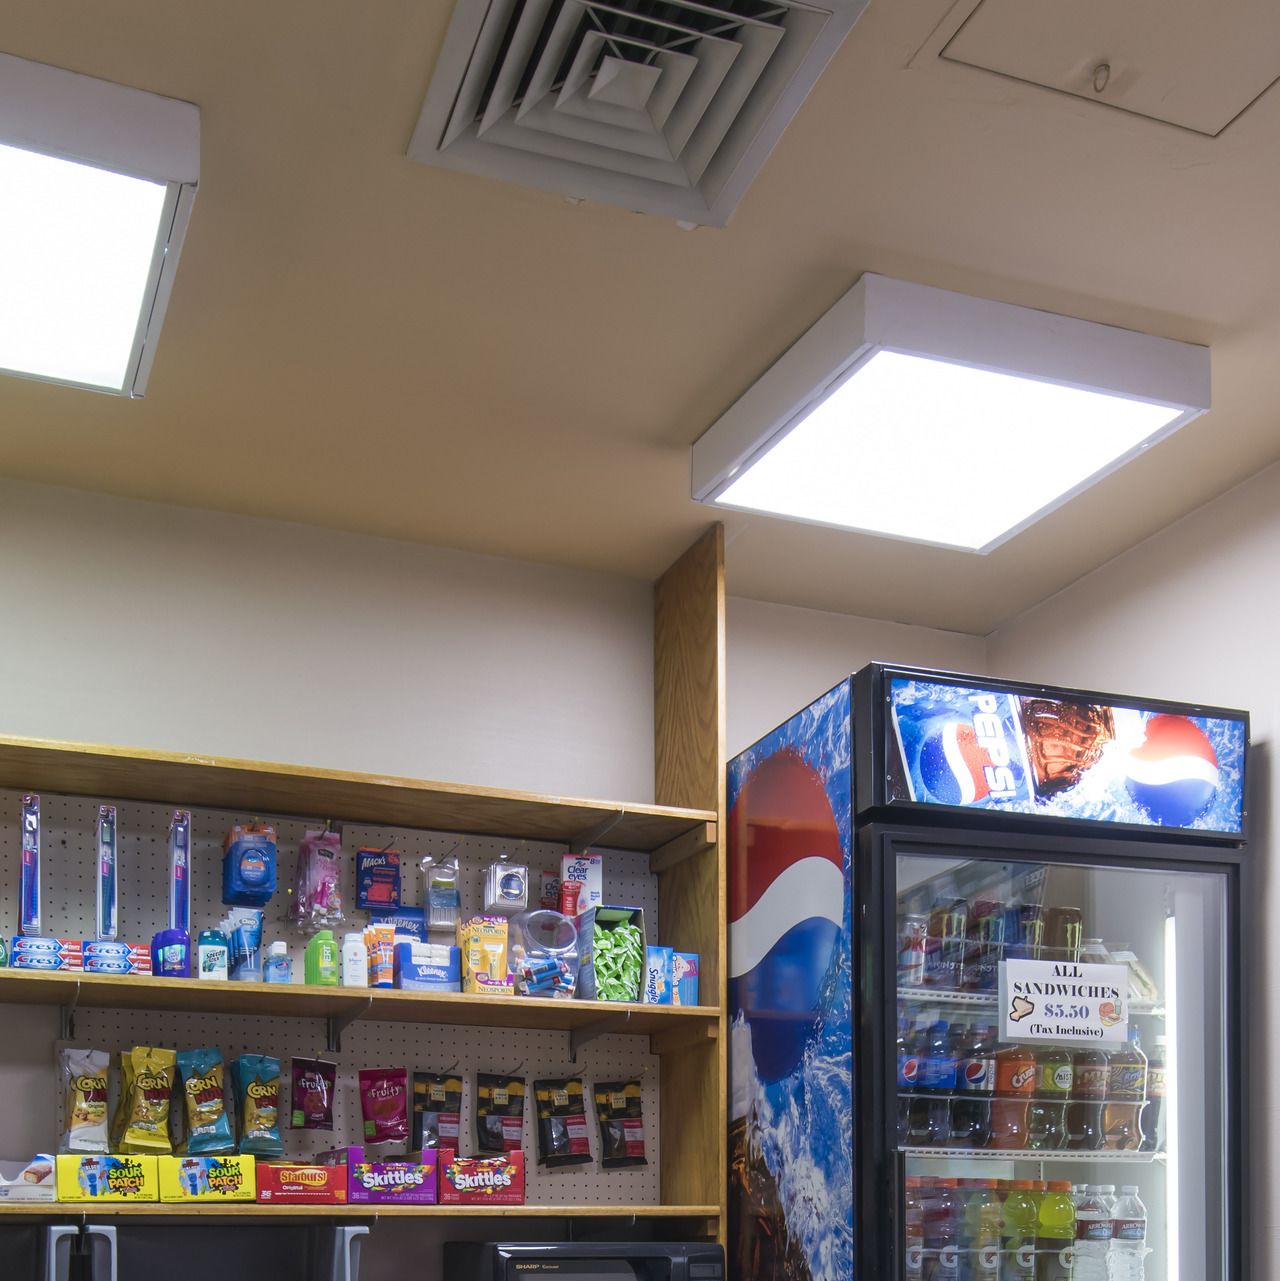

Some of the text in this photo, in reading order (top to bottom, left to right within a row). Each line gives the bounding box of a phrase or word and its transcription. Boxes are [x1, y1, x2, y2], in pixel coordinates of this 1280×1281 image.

[968, 696, 1016, 798] PEPSI
[361, 856, 387, 870] MACK'S
[567, 865, 589, 874] Clear
[568, 873, 587, 881] eyes
[471, 926, 507, 936] NEOSPORIN
[16, 940, 60, 951] Crest
[85, 944, 128, 955] Crest
[16, 955, 60, 967] Crest
[85, 959, 128, 969] Crest
[416, 966, 448, 978] Kleenex
[1052, 965, 1082, 977] ALL
[478, 986, 512, 994] NEOSPORIN
[648, 967, 659, 1003] Snuggle
[1014, 982, 1119, 998] SANDWICHES
[1030, 1024, 1104, 1037] (Tax Inclusive)
[76, 1077, 105, 1091] CORN
[109, 1167, 141, 1179] SOUR
[209, 1166, 239, 1178] SOUR
[280, 1170, 327, 1184] Starburst
[109, 1175, 144, 1188] PATCH
[209, 1174, 241, 1186] PATCH
[363, 1171, 424, 1190] Skittles
[455, 1173, 511, 1188] Skittles
